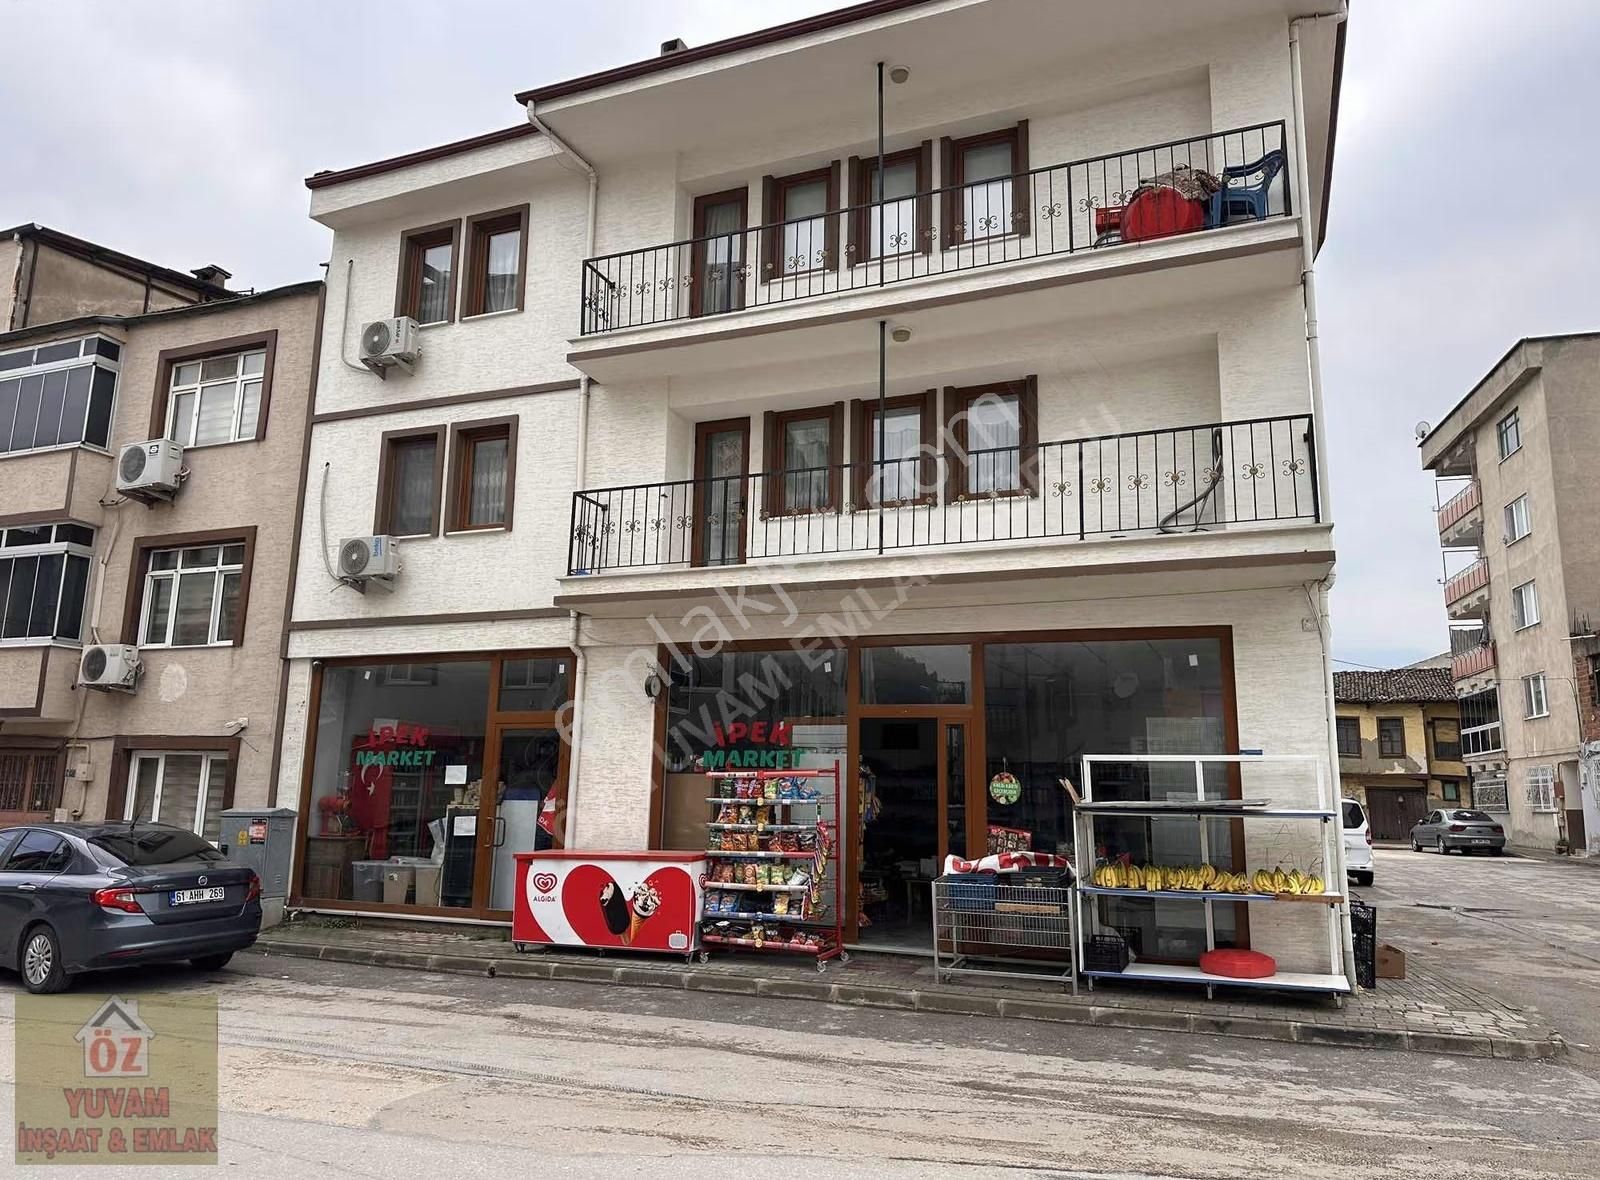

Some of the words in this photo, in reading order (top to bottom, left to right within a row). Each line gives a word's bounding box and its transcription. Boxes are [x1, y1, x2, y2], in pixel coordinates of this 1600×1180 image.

[355, 750, 437, 767] MARKET
[702, 748, 811, 768] MARKET
[176, 891, 185, 902] 61
[189, 890, 204, 900] AHH
[209, 888, 223, 898] 269
